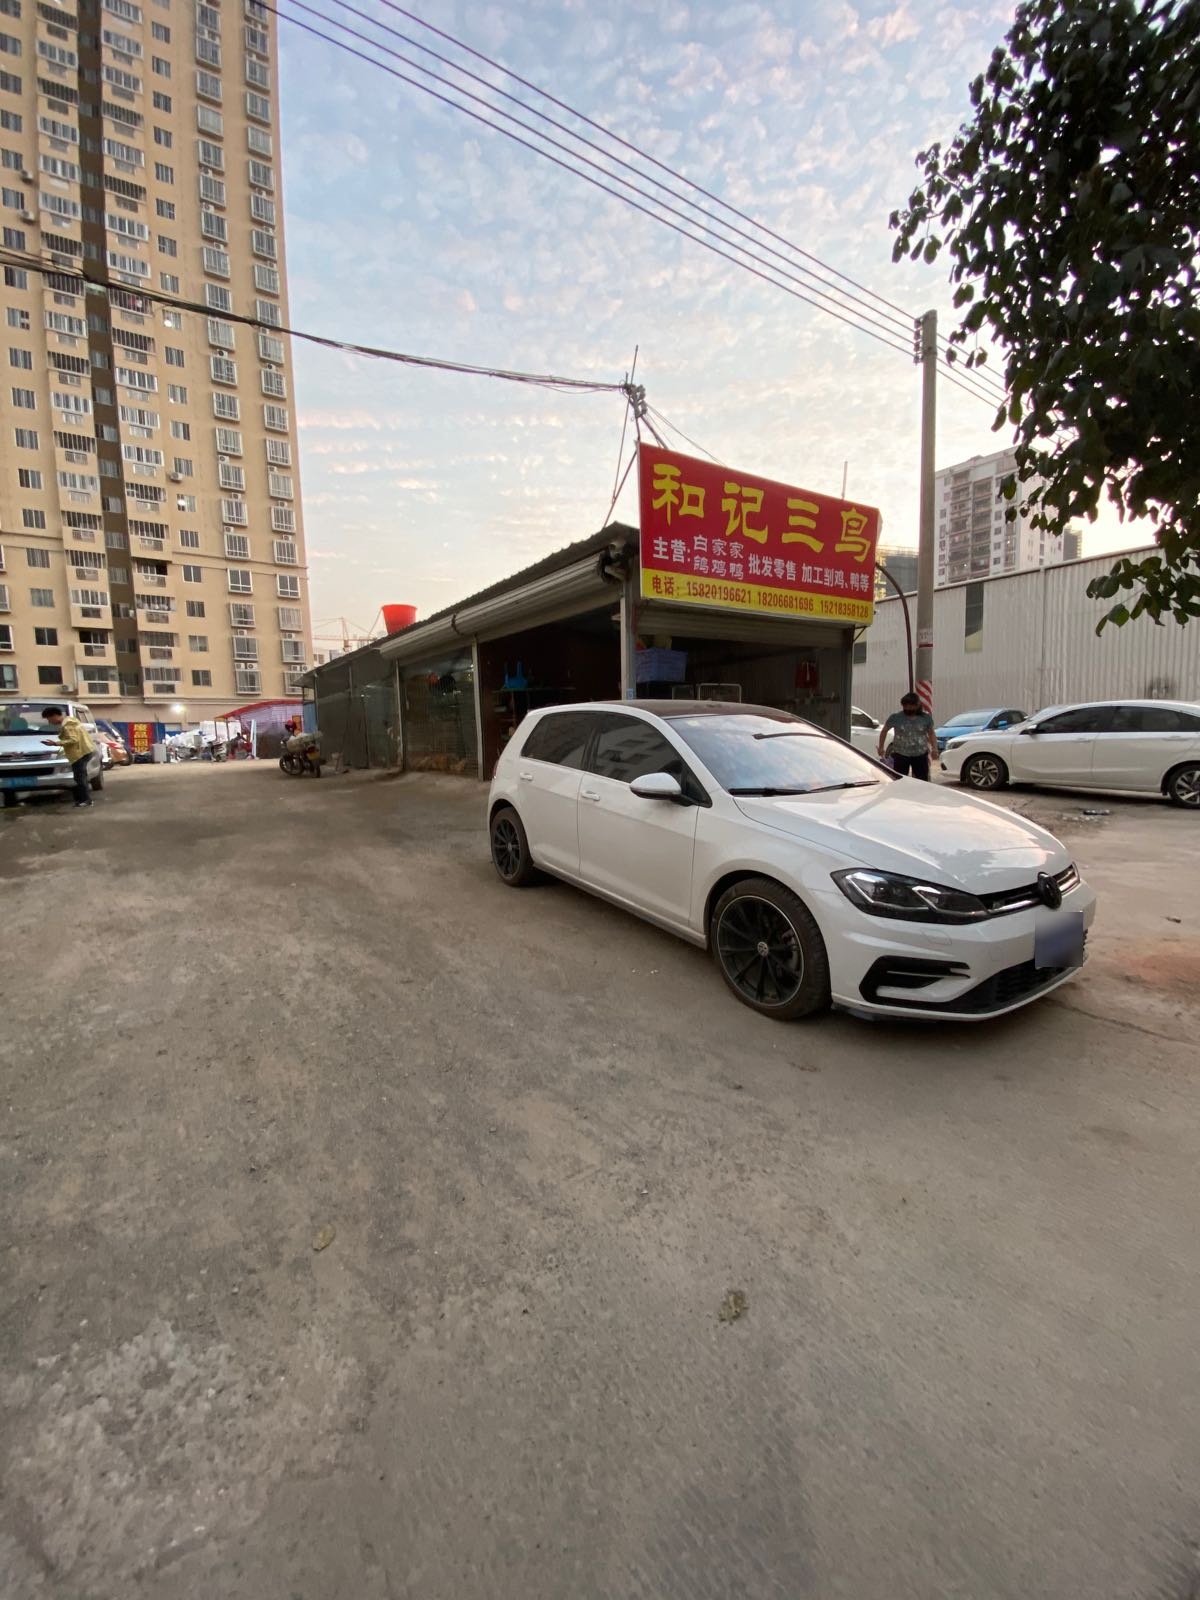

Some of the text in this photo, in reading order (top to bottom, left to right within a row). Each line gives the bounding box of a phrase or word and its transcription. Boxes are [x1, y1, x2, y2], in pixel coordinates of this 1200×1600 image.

[652, 463, 871, 563] 和记三鸟
[748, 553, 797, 582] 批发零售
[686, 581, 752, 604] 15820196621
